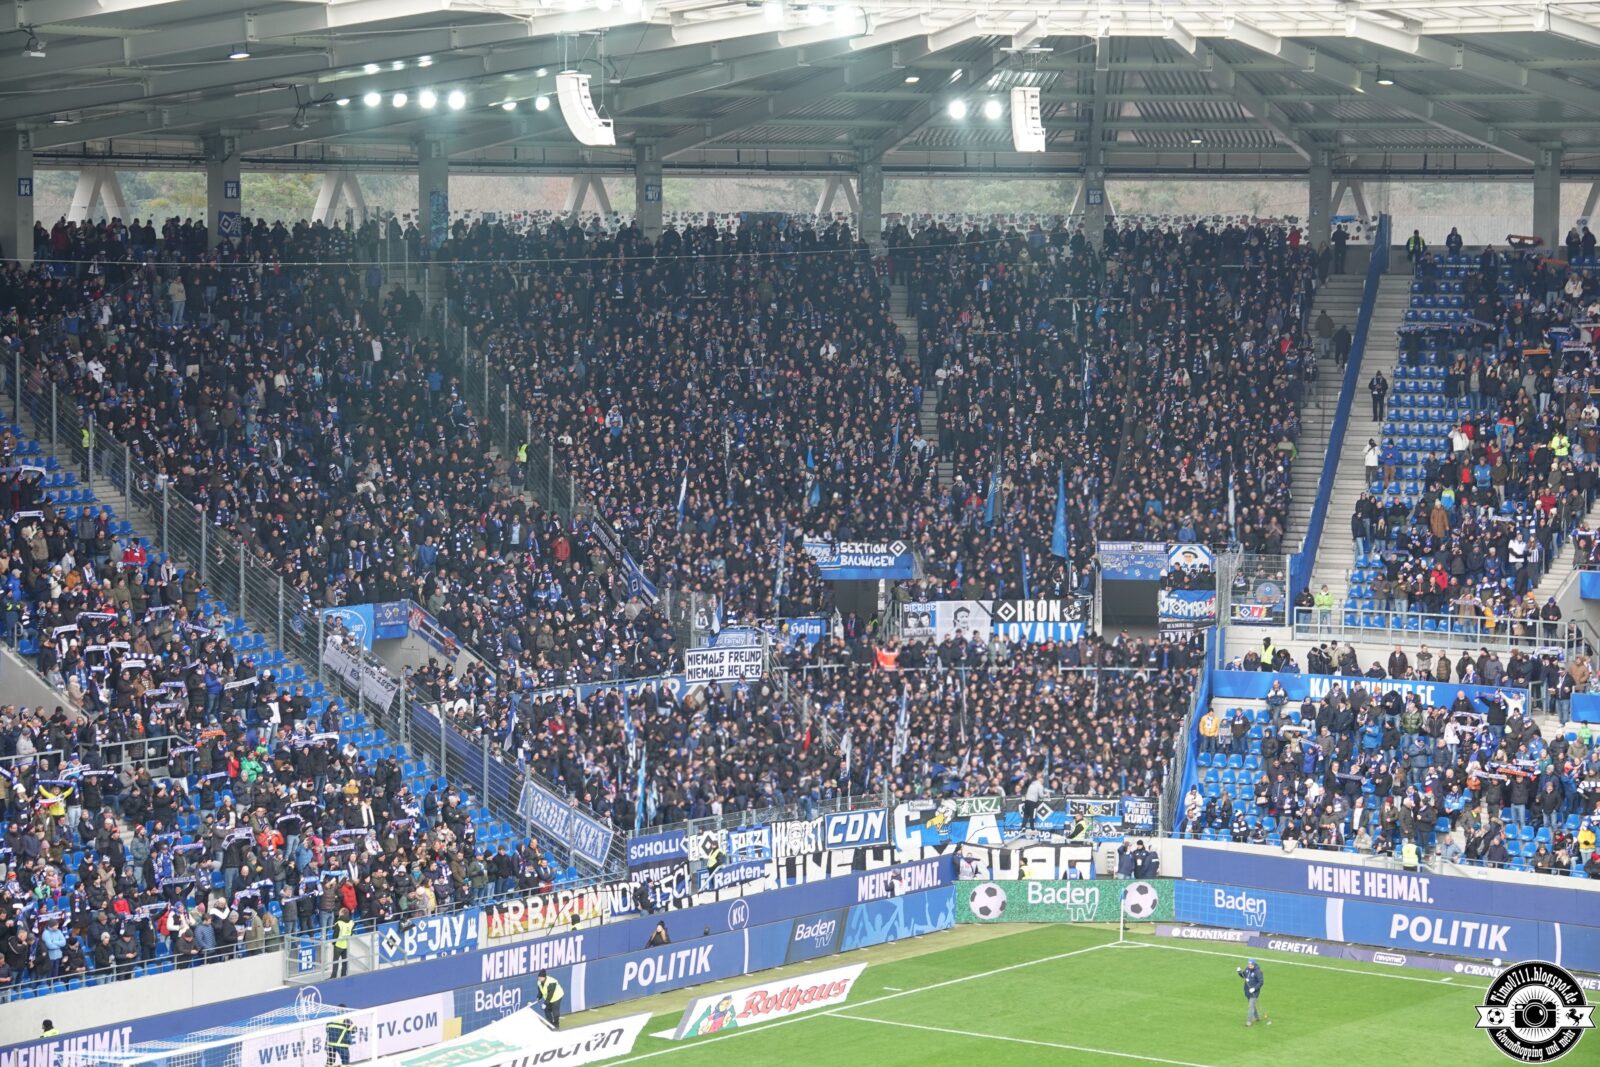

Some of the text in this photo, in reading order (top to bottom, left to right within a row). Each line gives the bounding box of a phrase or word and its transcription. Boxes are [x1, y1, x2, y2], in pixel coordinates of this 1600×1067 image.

[840, 541, 887, 555] SEKTION
[840, 555, 895, 567] BAUWAGEN
[1017, 600, 1060, 621] IRON
[687, 650, 761, 666] NIEMALS FREUND
[687, 664, 761, 679] NIEMALS HELFER
[1124, 814, 1154, 825] KURVE
[630, 838, 680, 859] SCHOLLI
[1028, 881, 1099, 904] Baden
[1308, 865, 1434, 904] MEINE HEIMAT.
[1214, 888, 1266, 913] Baden
[732, 904, 745, 926] KSC
[1066, 903, 1098, 921] TV
[1243, 910, 1266, 927] TV
[795, 919, 836, 941] Baden
[815, 932, 833, 948] TV
[1181, 928, 1243, 941] CRONIMET
[1390, 914, 1511, 951] POLITIK
[1268, 940, 1319, 955] CREMETAL
[482, 935, 586, 982] MEINE HEIMAT.
[622, 944, 714, 991] POLITIK
[1464, 964, 1505, 978] CRONI
[475, 985, 521, 1012] Baden
[736, 979, 848, 1019] Rothaus
